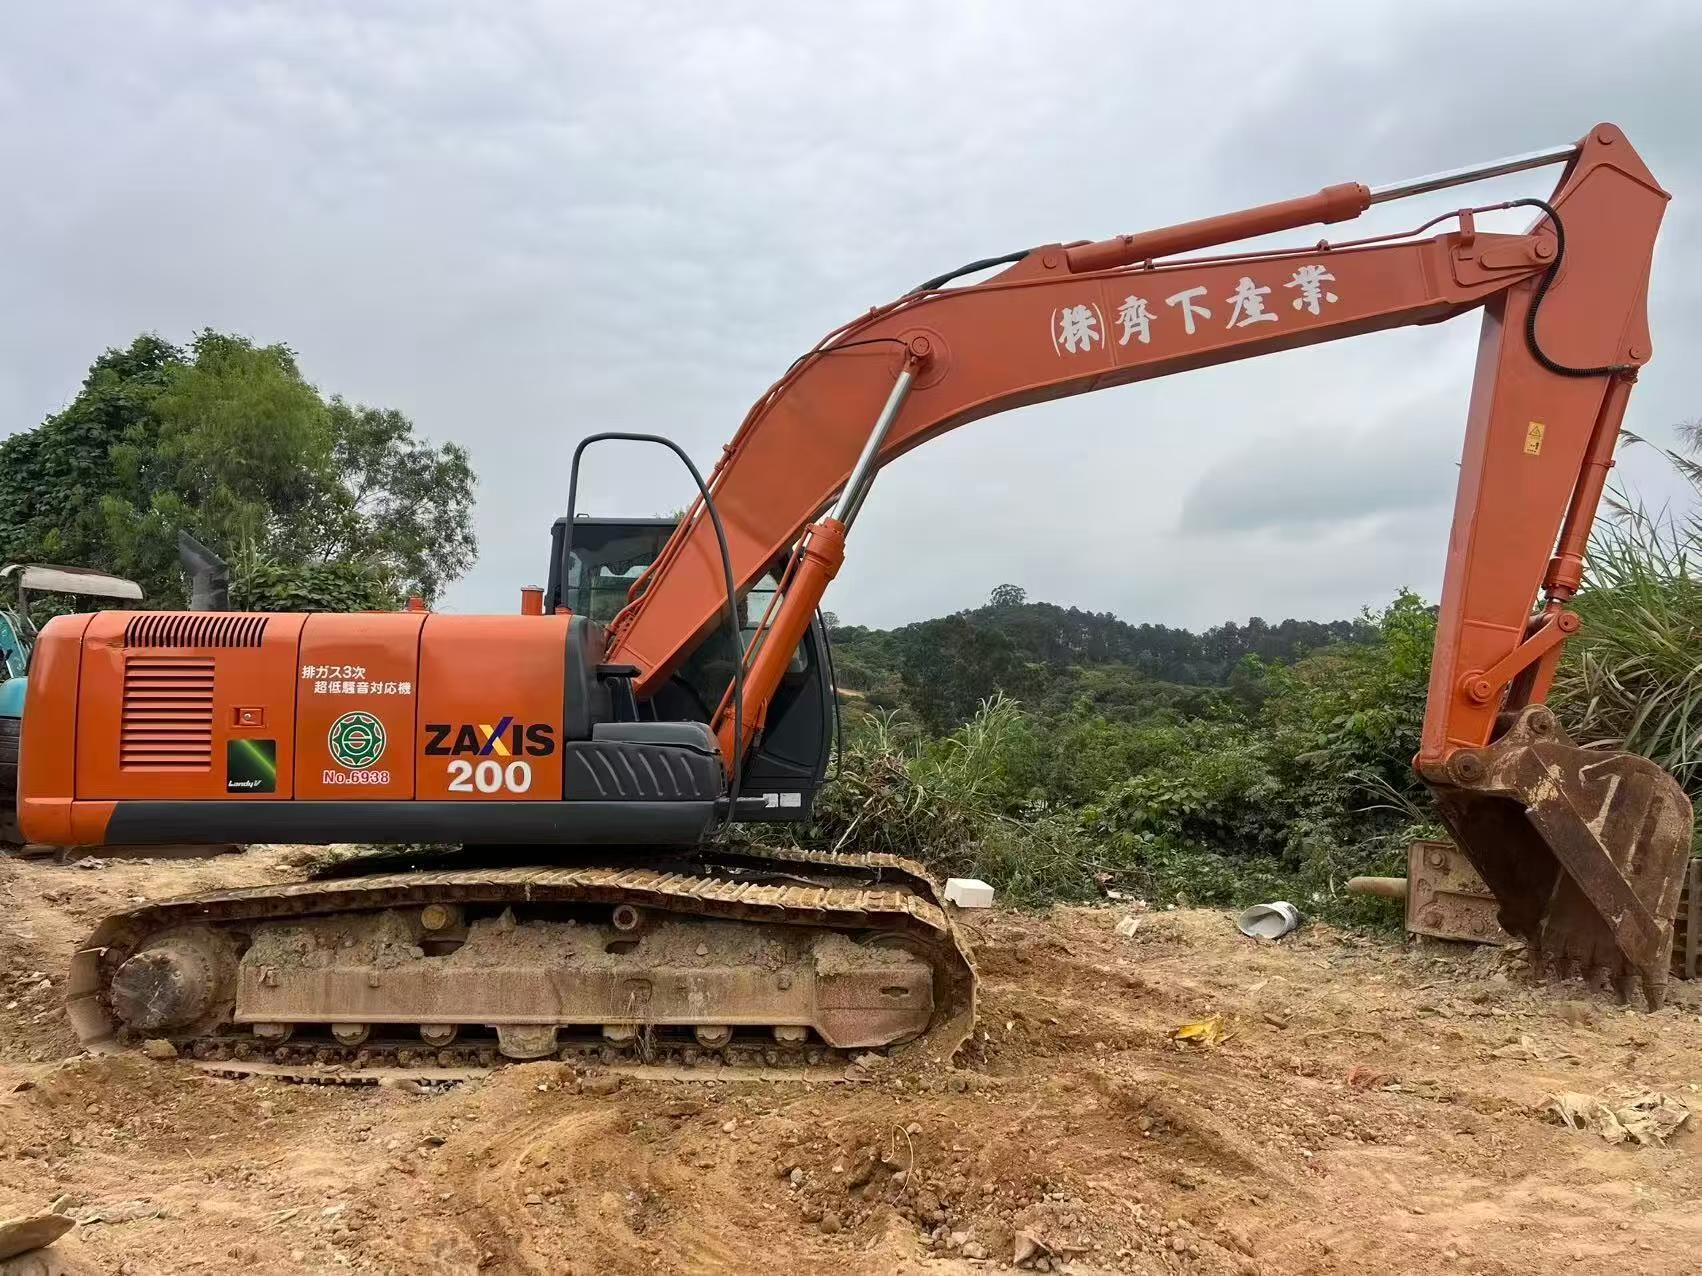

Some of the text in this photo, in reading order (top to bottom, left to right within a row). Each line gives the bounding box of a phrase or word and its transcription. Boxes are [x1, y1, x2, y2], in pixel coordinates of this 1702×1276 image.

[301, 665, 366, 679] 排ガス3次
[424, 716, 555, 757] ZAXIS
[322, 769, 390, 784] No.6938
[447, 760, 532, 793] 200
